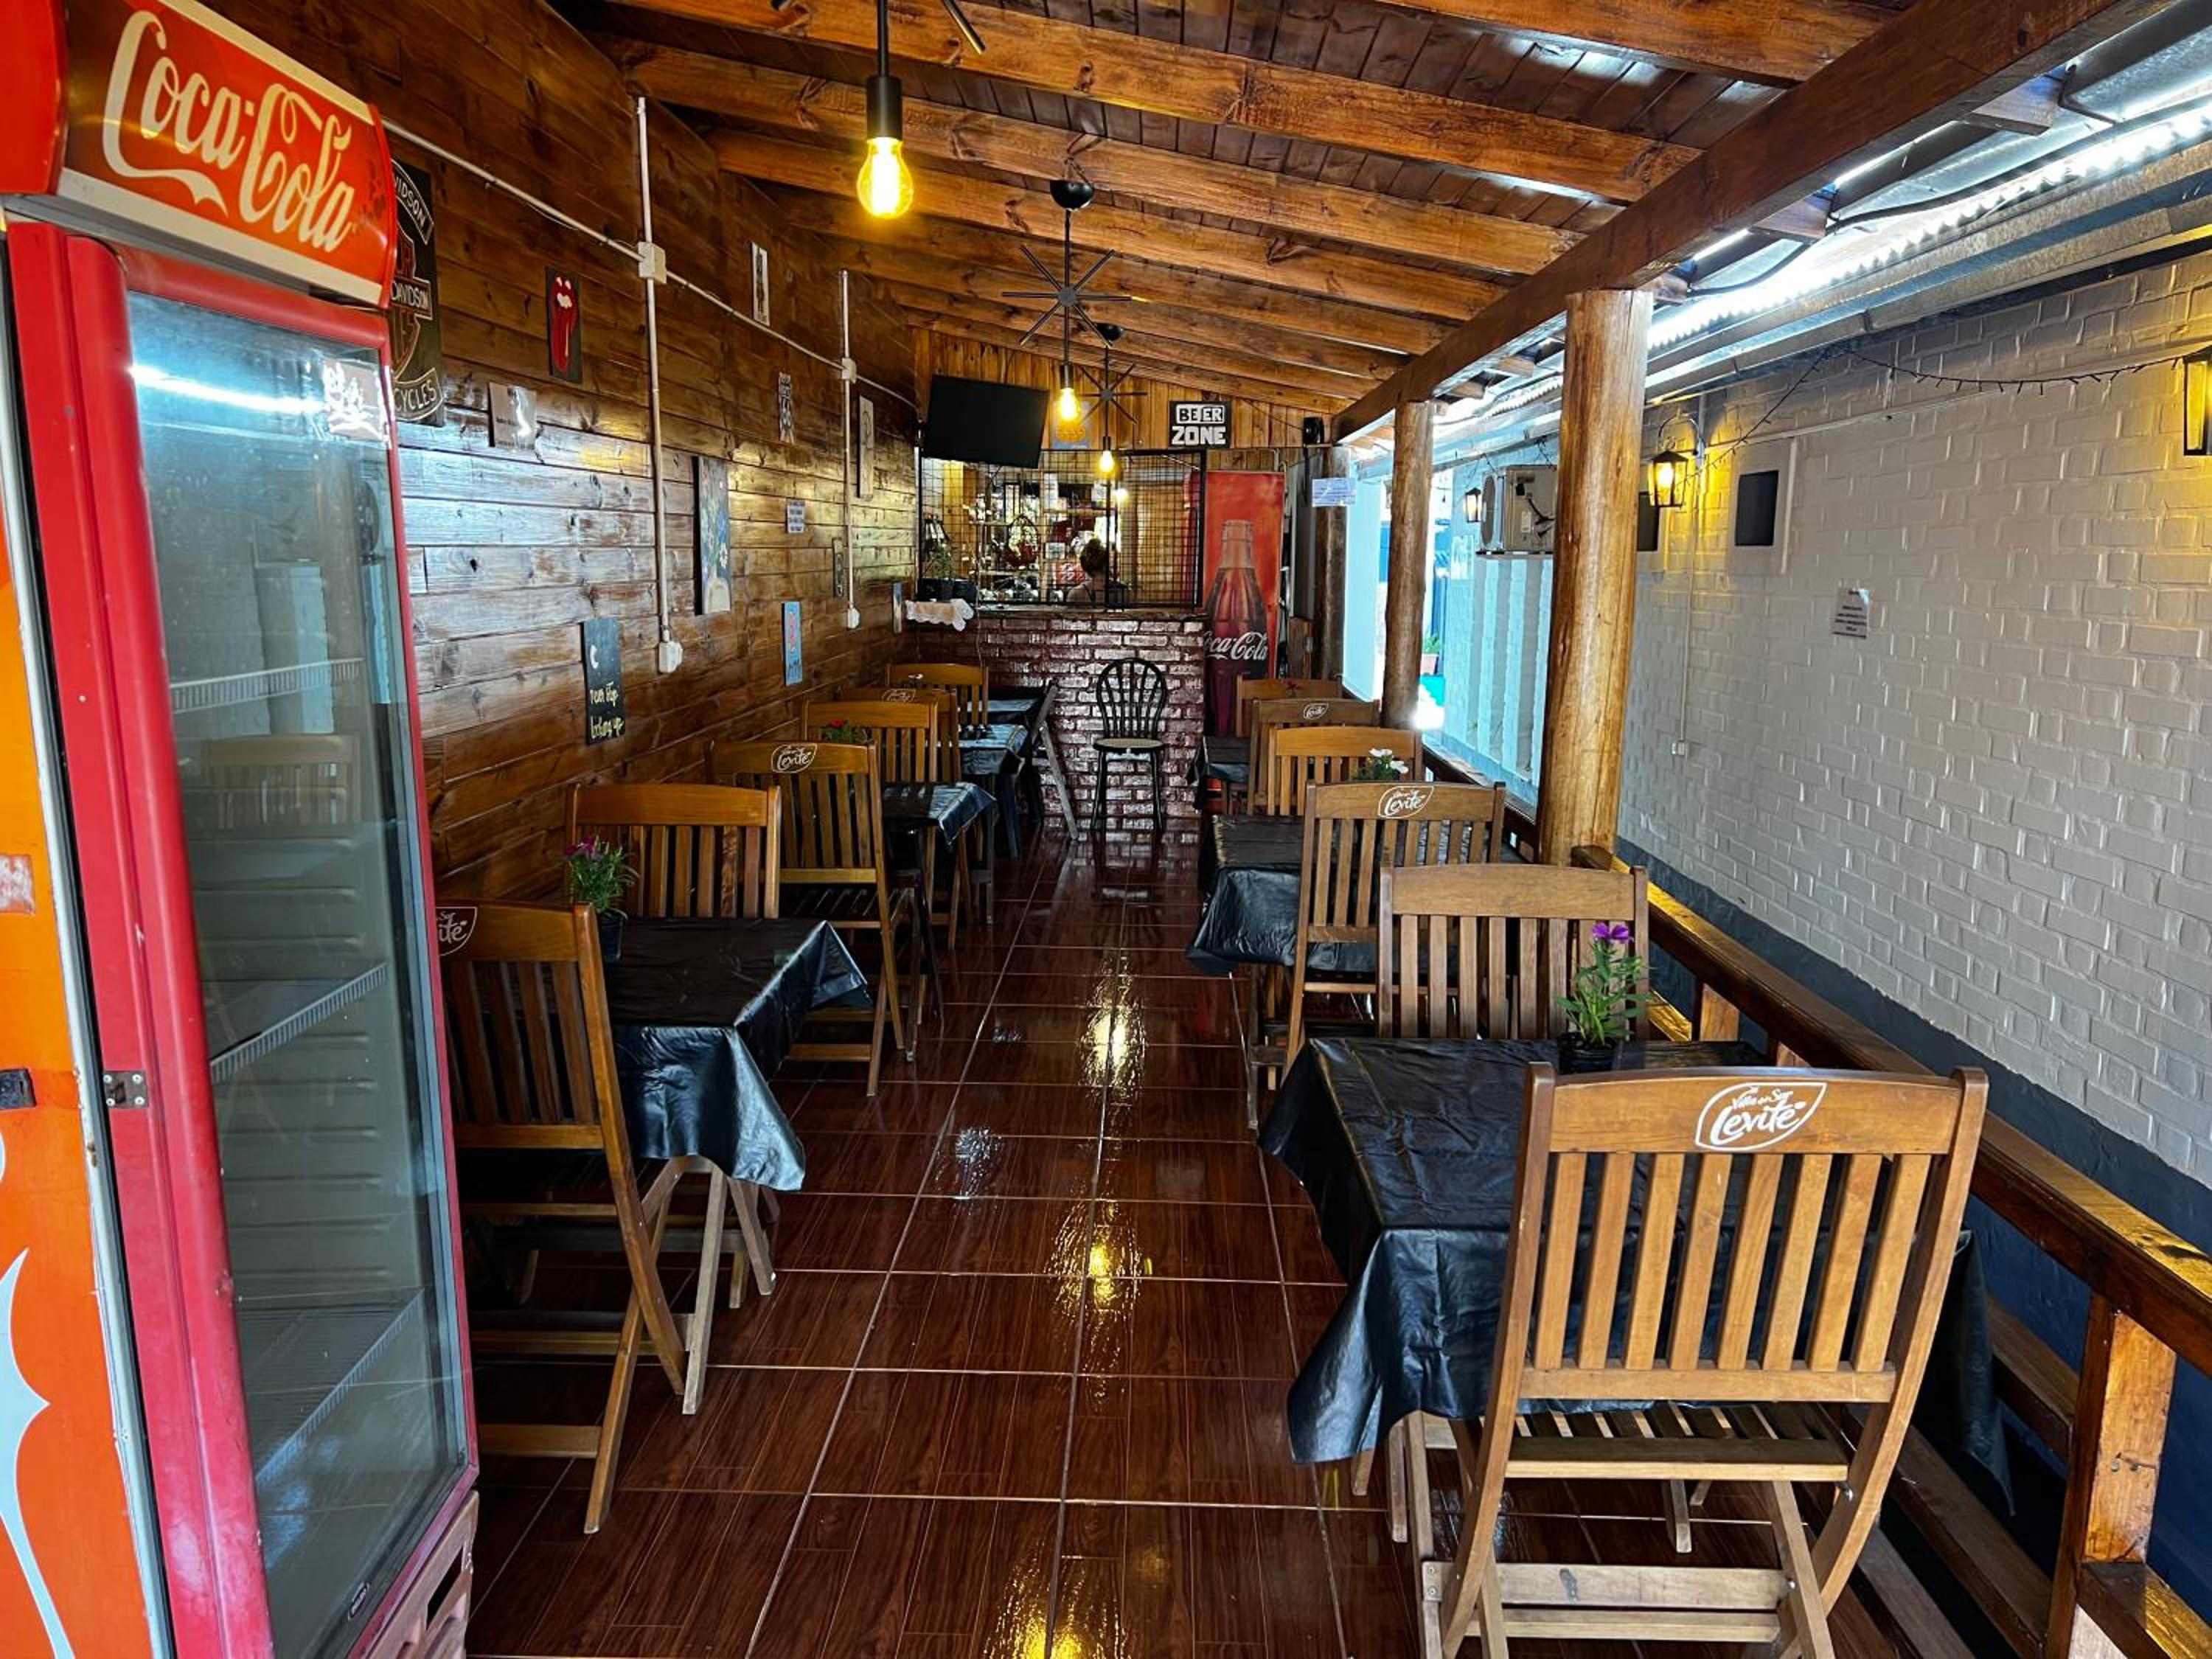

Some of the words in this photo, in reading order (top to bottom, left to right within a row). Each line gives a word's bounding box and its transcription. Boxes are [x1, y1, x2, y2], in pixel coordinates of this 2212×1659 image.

[102, 10, 355, 252] Coca-Cola
[394, 175, 426, 228] VIDSON
[1178, 406, 1223, 422] BEER
[1171, 425, 1226, 445] ZONE
